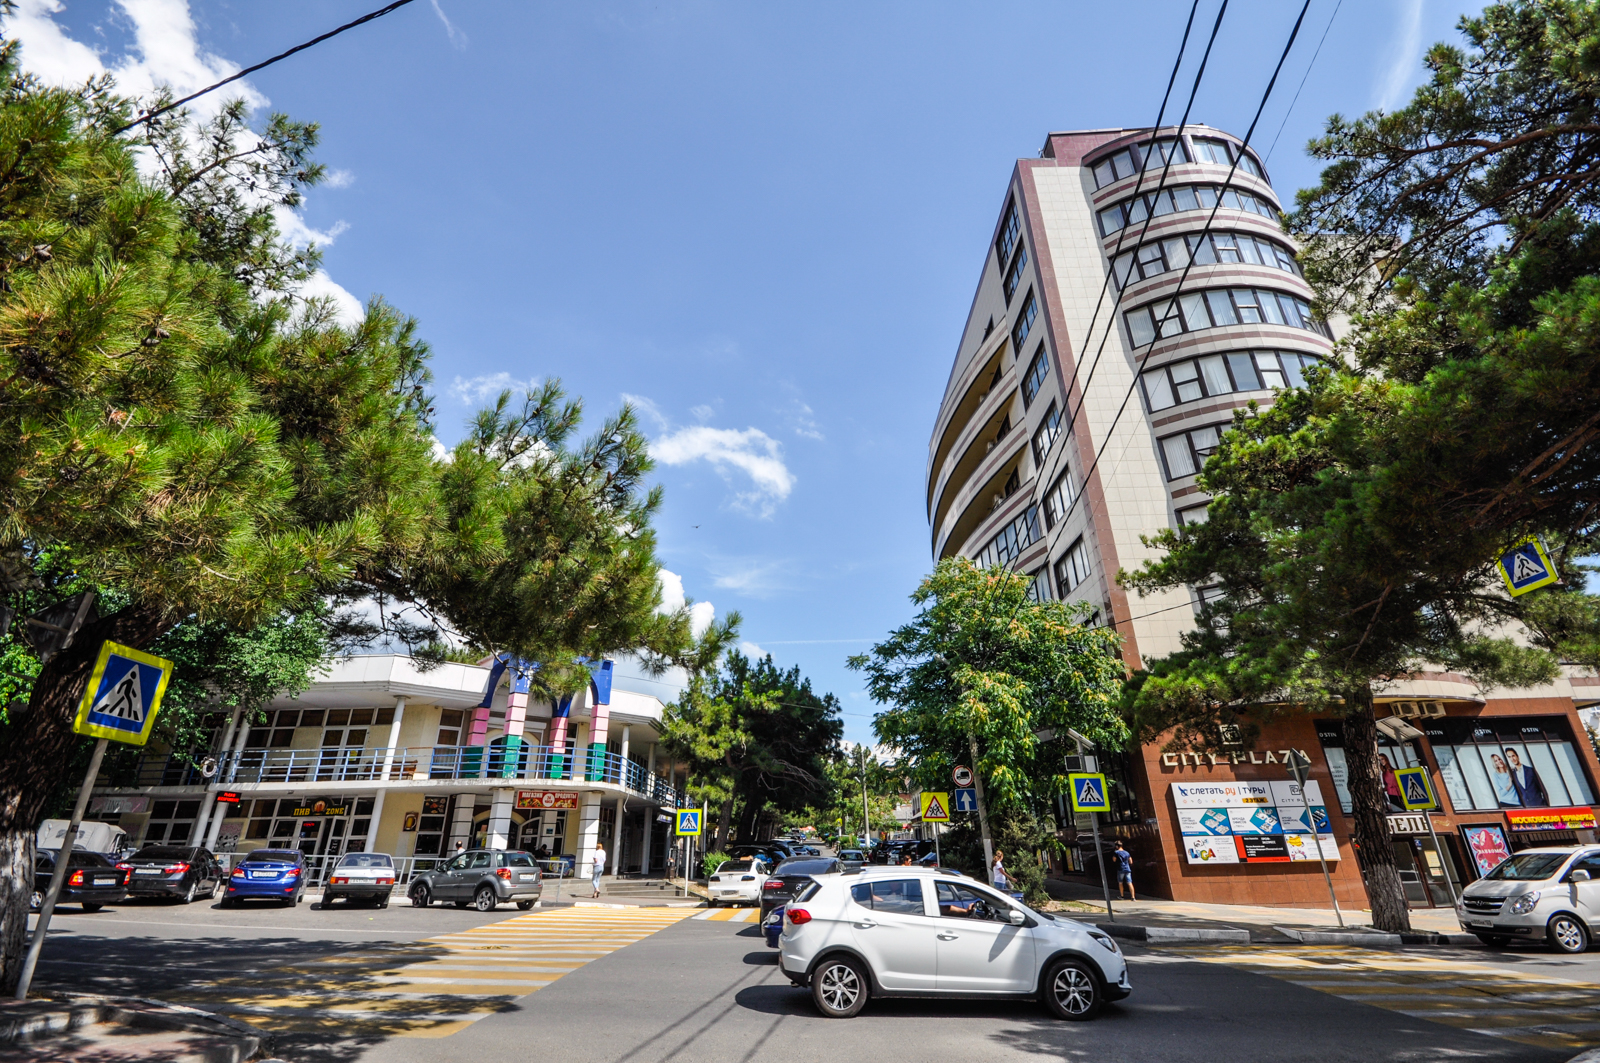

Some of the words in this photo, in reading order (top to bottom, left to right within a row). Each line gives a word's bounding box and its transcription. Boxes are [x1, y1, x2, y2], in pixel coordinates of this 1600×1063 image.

[1163, 751, 1216, 766] CITY
[1189, 787, 1236, 796] слетать.ру
[1242, 786, 1266, 794] ТУРЫ
[1510, 815, 1561, 824] МОСКОВСКАЯ
[1561, 814, 1596, 822] ЯРМАРКА
